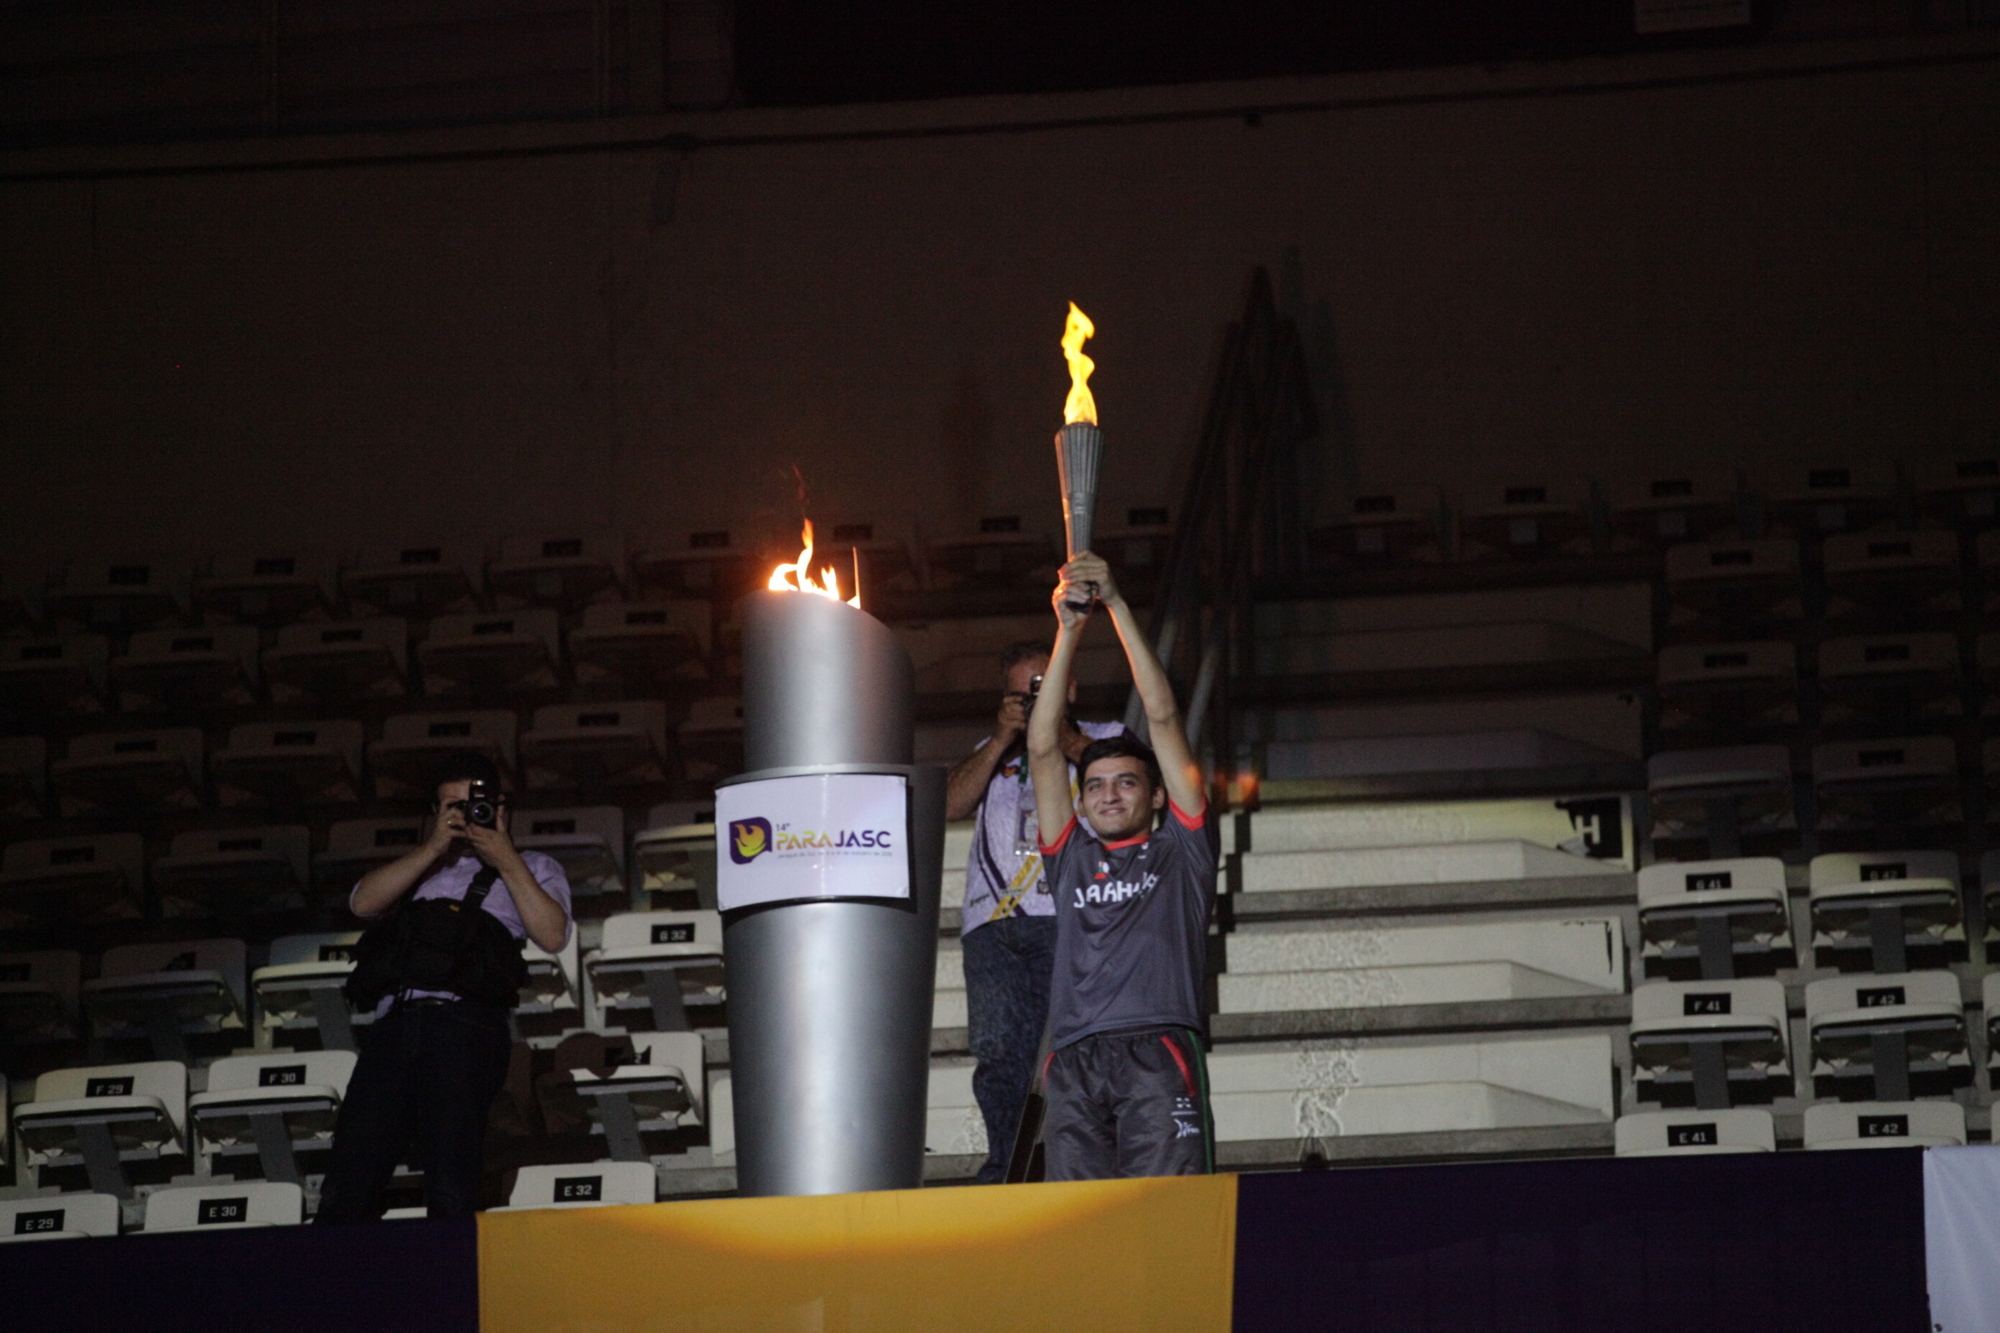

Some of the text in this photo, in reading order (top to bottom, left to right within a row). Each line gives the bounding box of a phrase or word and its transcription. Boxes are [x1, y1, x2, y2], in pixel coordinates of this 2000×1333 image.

[670, 929, 687, 941] 32
[1694, 1000, 1721, 1012] F 41
[1867, 994, 1896, 1006] F 42
[269, 1072, 297, 1084] F 30
[96, 1084, 124, 1095] F 29
[1869, 1122, 1899, 1135] E 42
[1679, 1131, 1707, 1144] E 41
[563, 1184, 592, 1197] E 32
[209, 1205, 237, 1218] E 30
[25, 1218, 54, 1231] E 29
